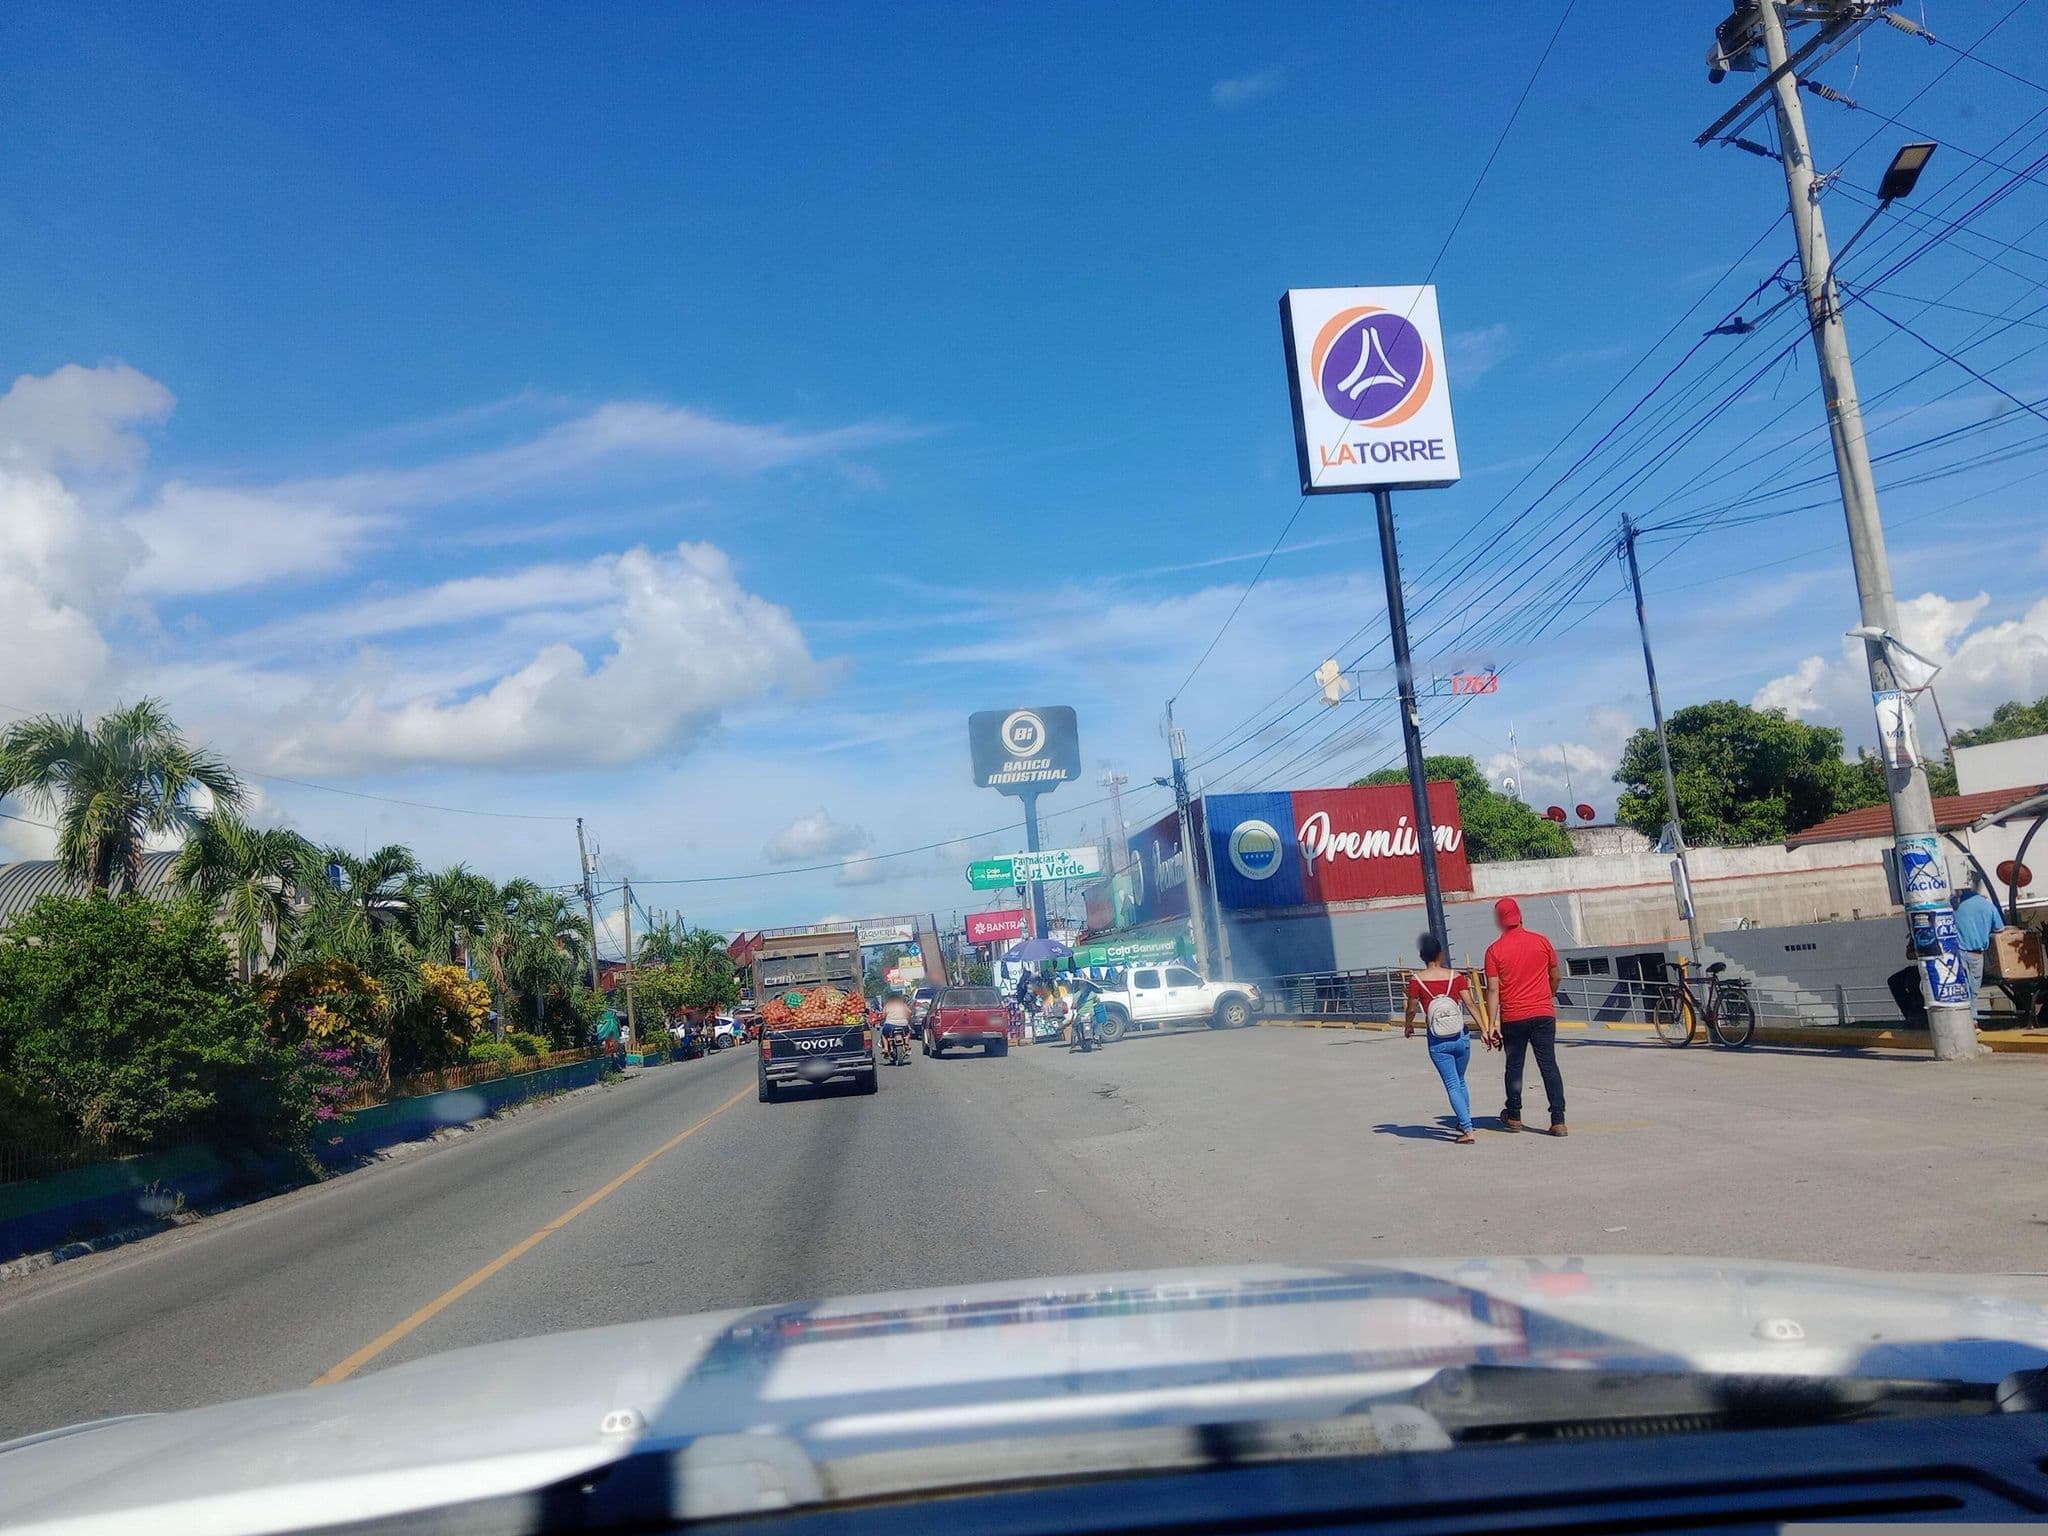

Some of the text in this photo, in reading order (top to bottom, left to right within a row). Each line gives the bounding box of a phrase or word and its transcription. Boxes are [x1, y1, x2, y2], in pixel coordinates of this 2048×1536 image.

[1003, 758, 1051, 773] BANCO
[988, 769, 1068, 785] INDUSTRIAL
[1046, 860, 1085, 877] Verde
[1107, 946, 1130, 957] Caja
[794, 1037, 844, 1050] TOYOTA
